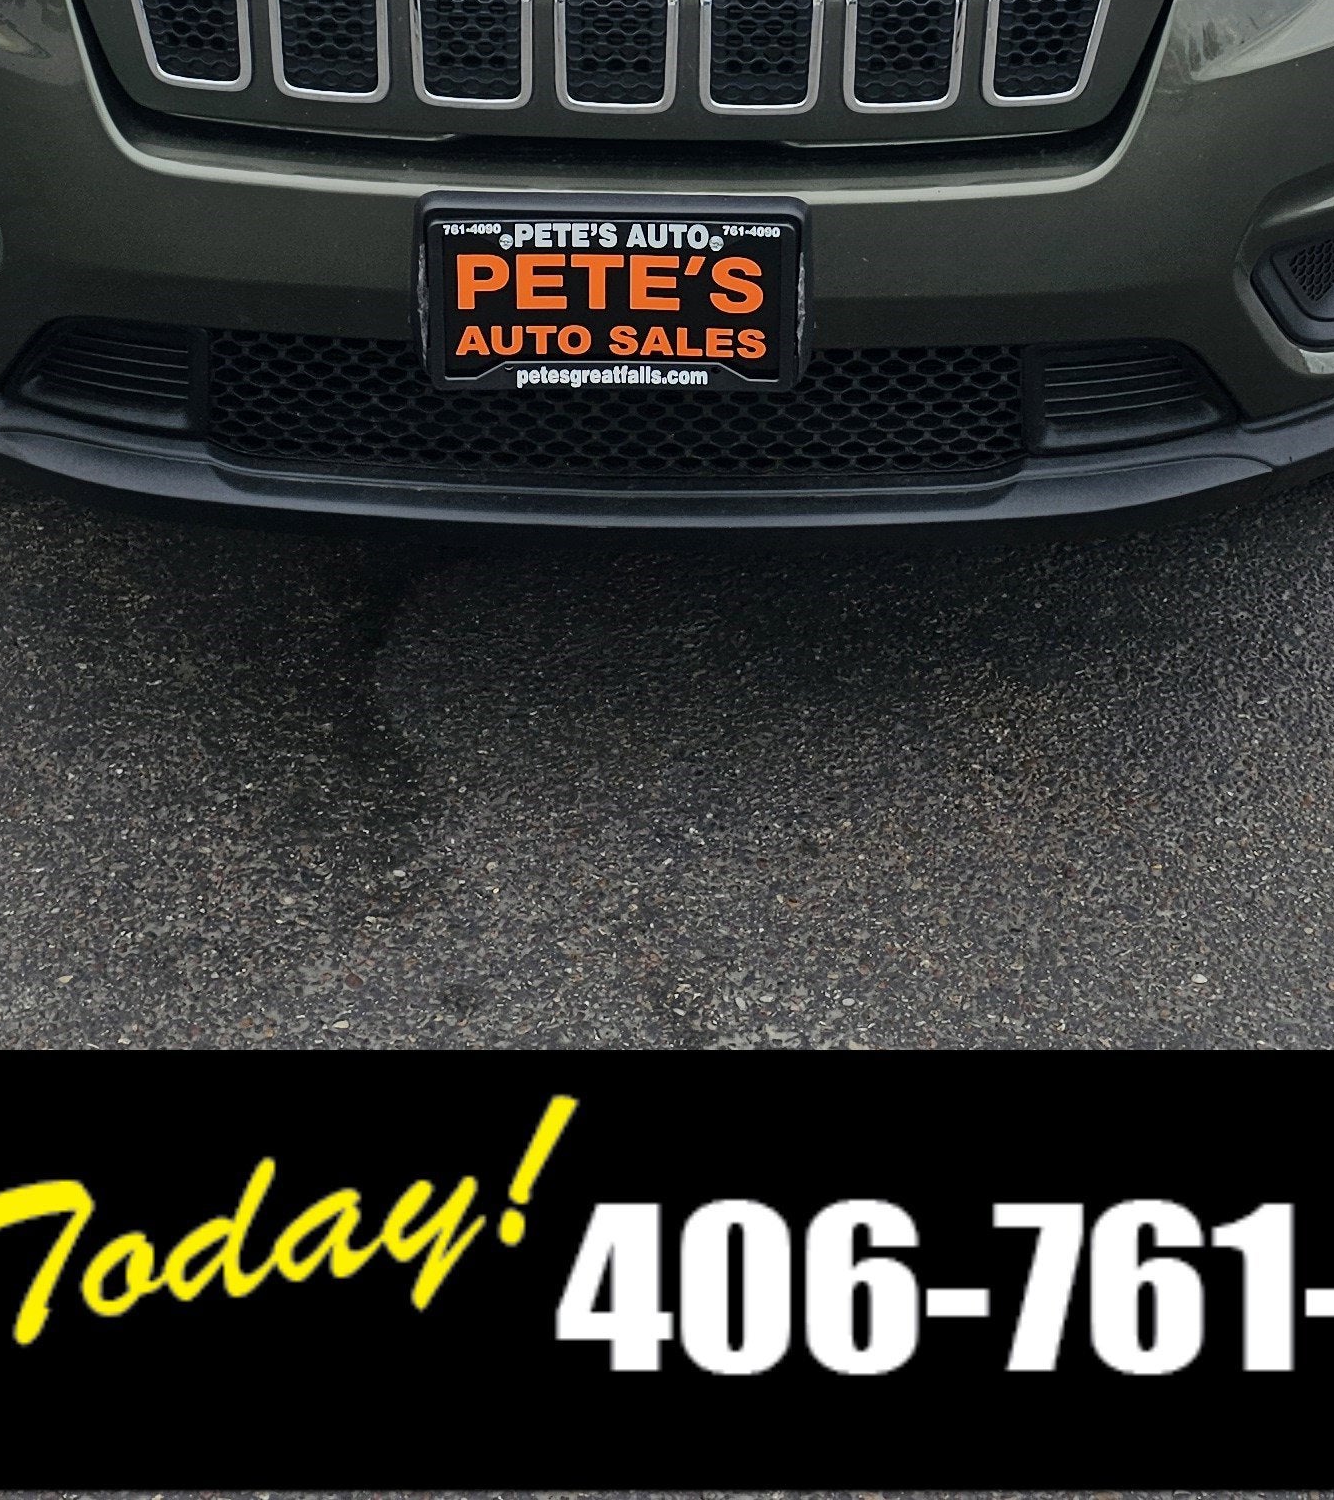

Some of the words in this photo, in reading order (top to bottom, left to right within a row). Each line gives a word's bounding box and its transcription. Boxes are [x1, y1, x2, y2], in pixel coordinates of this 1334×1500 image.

[442, 224, 502, 236] 761-4090
[514, 222, 619, 249] PETE'S
[626, 223, 710, 250] AUTO
[722, 225, 781, 239] 761-4090
[456, 253, 765, 315] PETE'S
[455, 324, 593, 357] AUTO
[608, 325, 767, 360] SALES
[516, 364, 709, 388] petesgreatfalls.com
